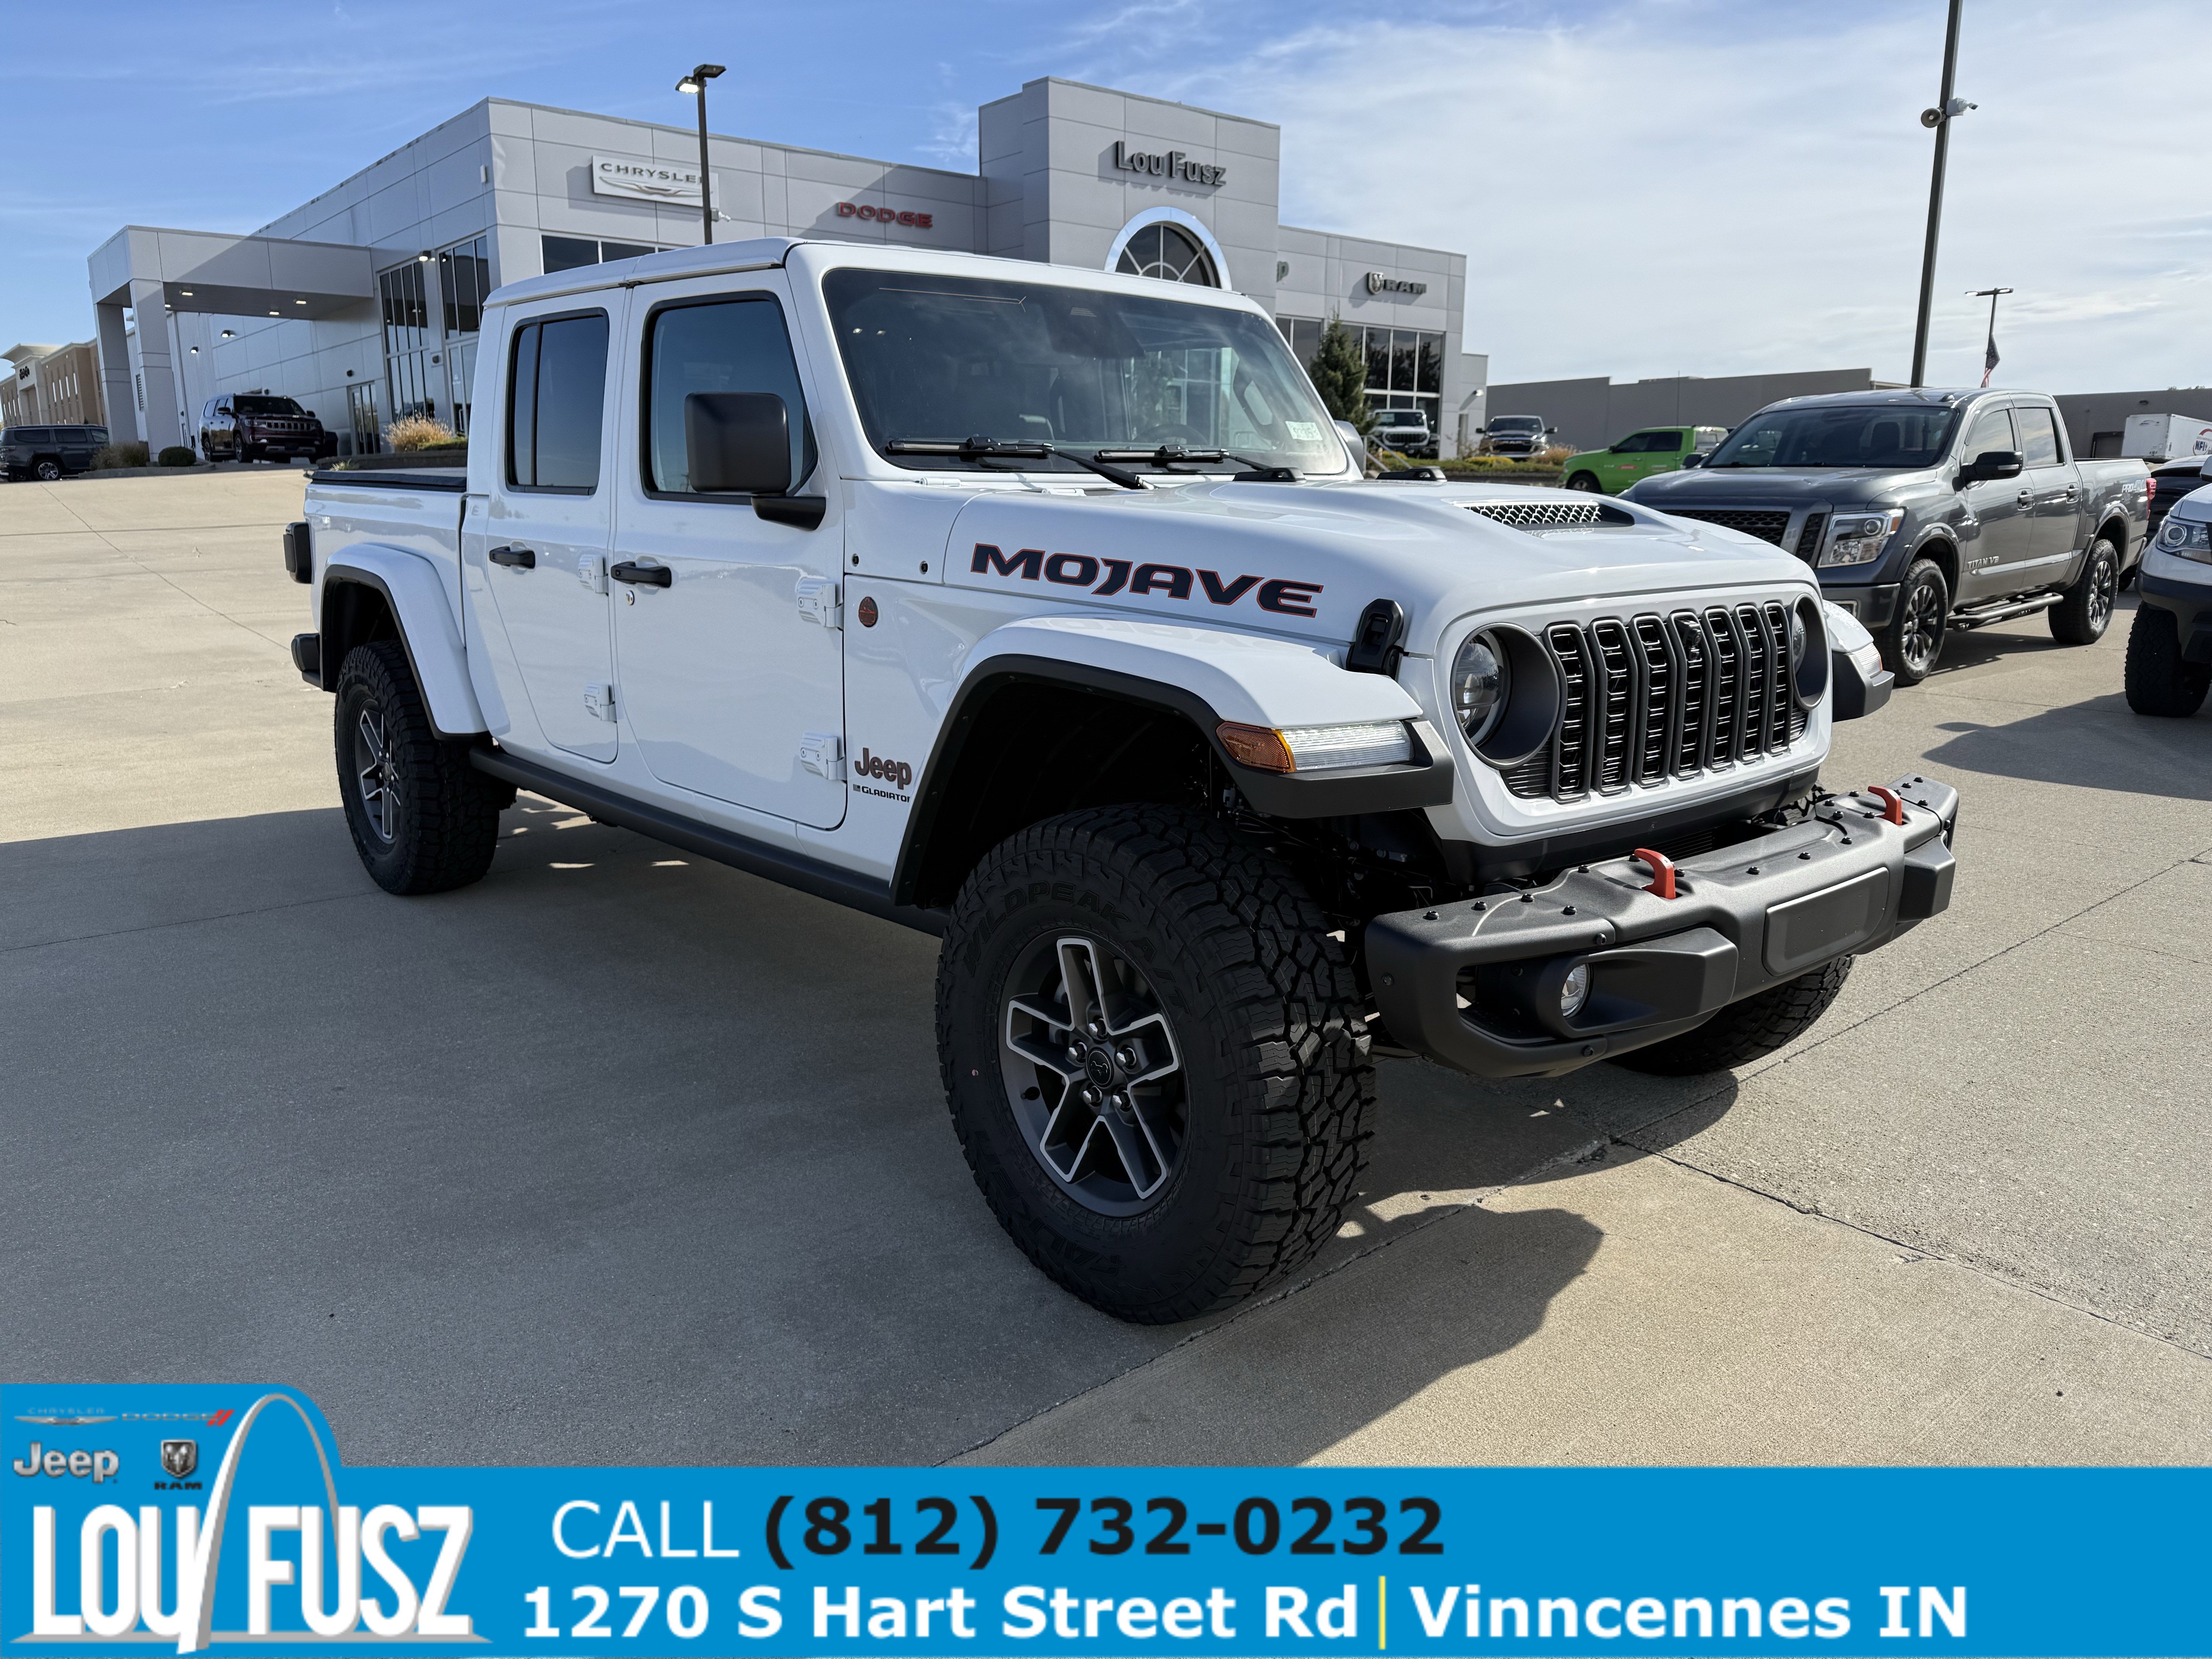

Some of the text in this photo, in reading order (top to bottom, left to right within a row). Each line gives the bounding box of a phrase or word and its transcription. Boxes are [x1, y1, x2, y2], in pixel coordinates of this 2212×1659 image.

[600, 163, 702, 184] CHRYSLE
[1117, 141, 1227, 185] Lou Fusz
[836, 202, 933, 228] DODGE
[1384, 264, 1427, 294] RAM
[2195, 440, 2205, 451] NFI
[1967, 558, 1988, 569] TITAN
[971, 543, 1324, 618] MOJAVE
[854, 747, 912, 790] Jeep
[963, 880, 1131, 977] WILDPEAK
